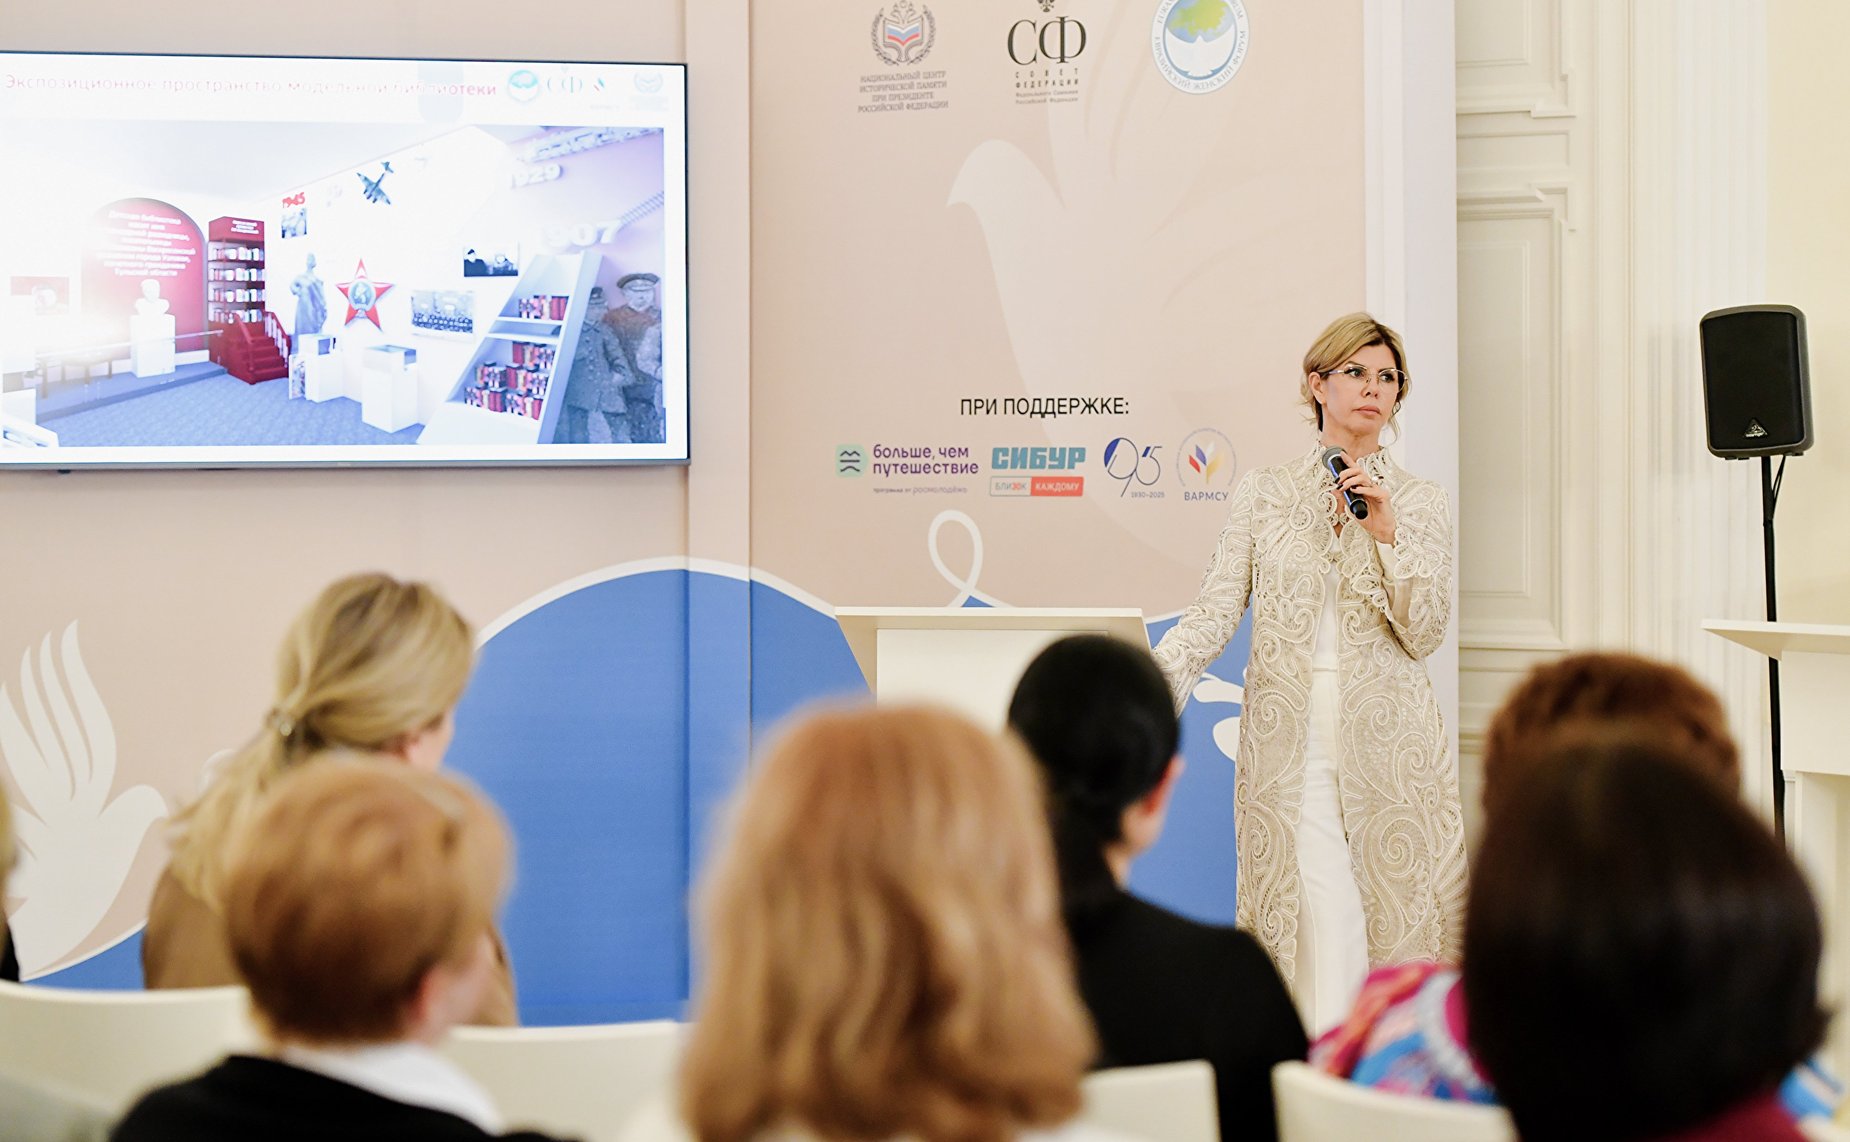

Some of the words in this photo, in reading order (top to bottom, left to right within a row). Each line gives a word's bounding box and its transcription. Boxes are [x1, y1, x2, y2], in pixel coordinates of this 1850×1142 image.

[1007, 16, 1087, 65] СФ
[1232, 30, 1246, 65] ФОРУМ
[860, 71, 921, 82] НАЦИОНАЛЬНЫЙ
[922, 70, 947, 79] ЦЕНТР
[1015, 68, 1078, 79] СОВЕТ
[5, 74, 154, 90] Экспозиционное
[163, 79, 281, 92] пространство
[859, 81, 915, 93] ИСТОРИЧЕСКОЙ
[916, 80, 948, 89] ПАМЯТИ
[1015, 78, 1078, 89] ФЕДЕРАЦИИ
[872, 94, 887, 102] ПРИ
[888, 91, 934, 102] ПРЕЗИДЕНТЕ
[857, 102, 905, 113] РОССИЙСКОЙ
[905, 100, 949, 111] ФЕДЕРАЦИИ
[960, 398, 997, 416] ПРИ
[1003, 397, 1130, 418] ПОДДЕРЖКЕ:
[872, 444, 936, 460] больше,
[938, 447, 969, 458] чем
[991, 447, 1087, 470] СИБУР
[872, 462, 980, 477] путешествие
[1034, 482, 1080, 492] КАЖДОМУ
[1184, 491, 1229, 501] ВАРМСУ
